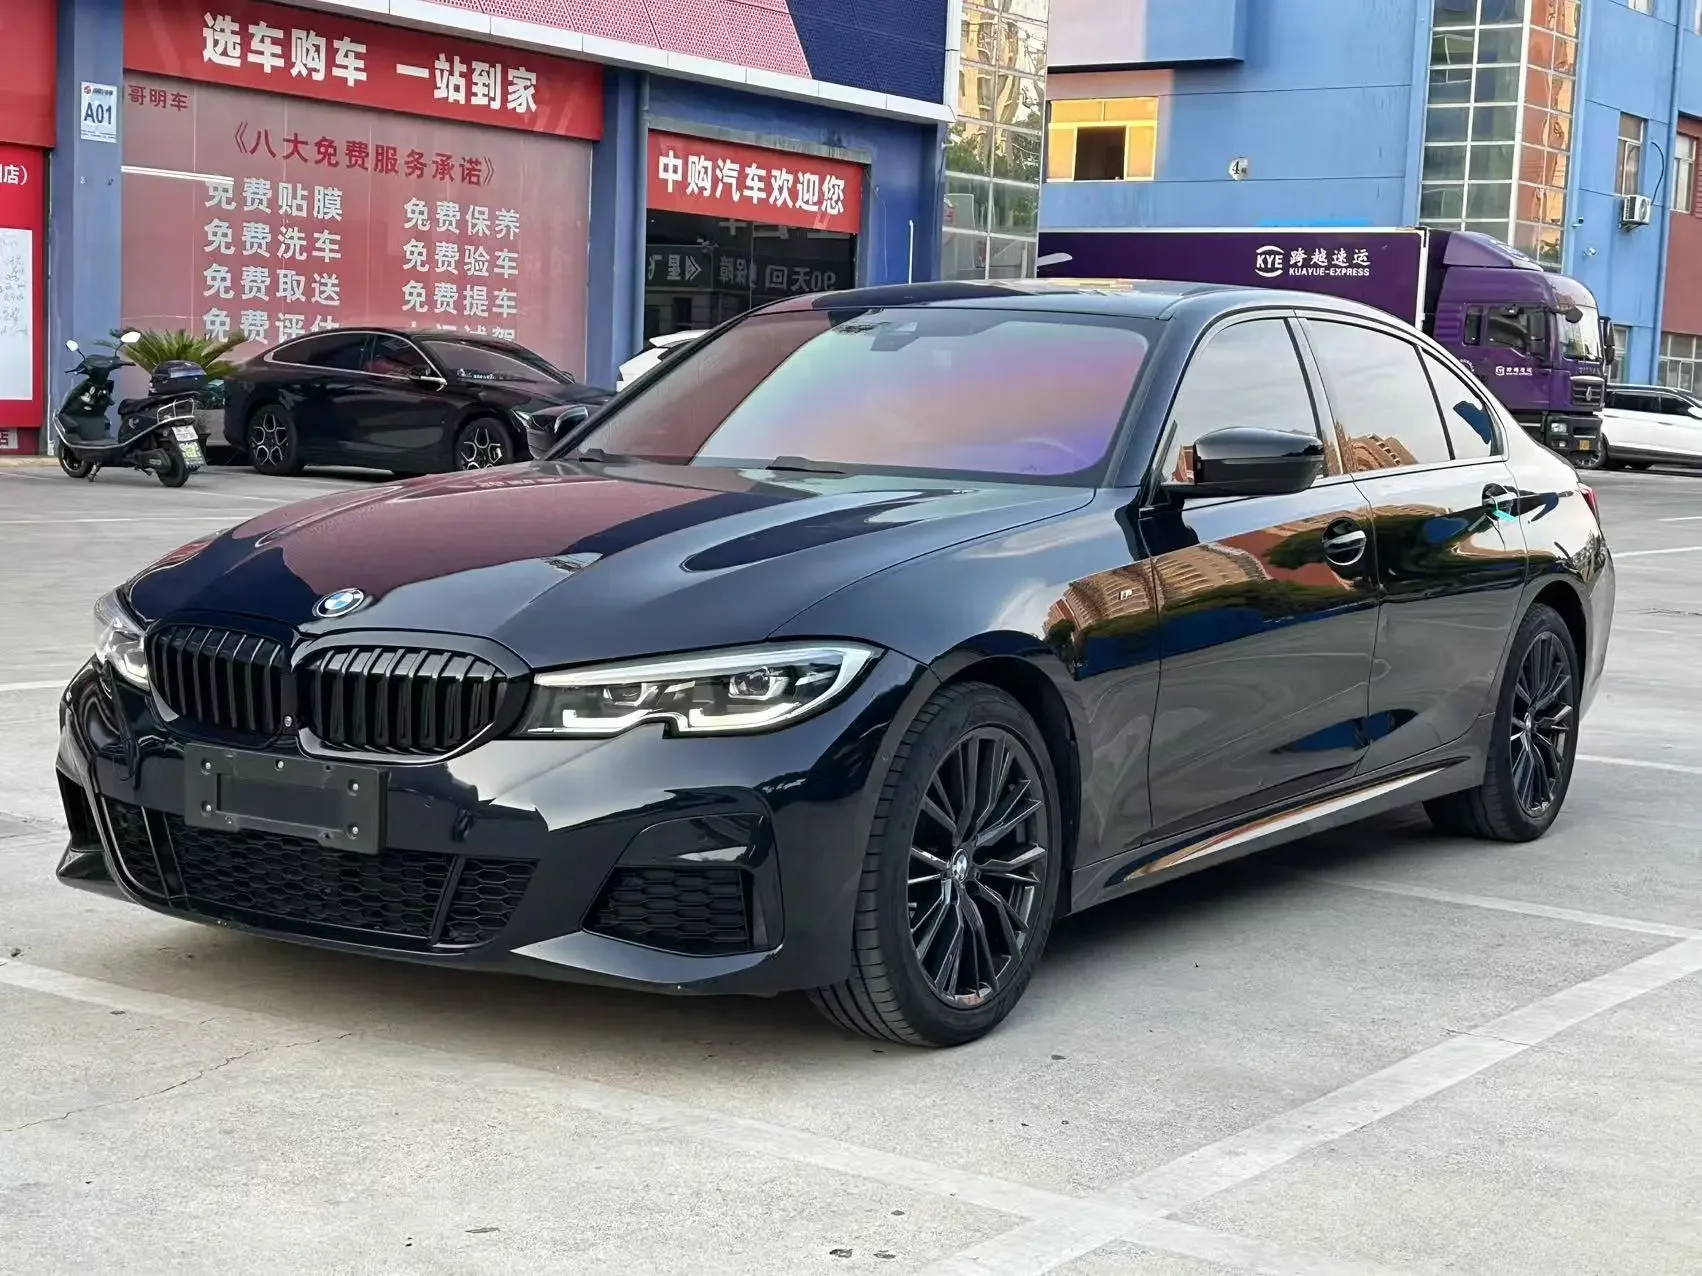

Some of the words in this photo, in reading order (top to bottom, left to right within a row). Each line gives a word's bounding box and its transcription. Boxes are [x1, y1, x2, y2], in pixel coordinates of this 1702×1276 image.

[202, 11, 367, 87] 选车购车
[396, 53, 537, 113] 一站到家
[84, 102, 112, 124] A01
[128, 84, 188, 111] 哥明车
[232, 121, 495, 186] 《八大免费服务承诺》
[205, 177, 343, 222] 免费贴膜
[658, 150, 845, 215] 中购汽车欢迎您
[403, 197, 520, 240] 免费保养
[203, 218, 342, 262] 免费洗车
[402, 238, 519, 278] 免费验车
[1289, 248, 1370, 266] 跨越速运
[1256, 254, 1283, 268] KYE
[1289, 267, 1370, 276] KUAYUE-EXPRESS
[202, 263, 341, 306] 免费取送
[402, 281, 518, 318] 免费提车
